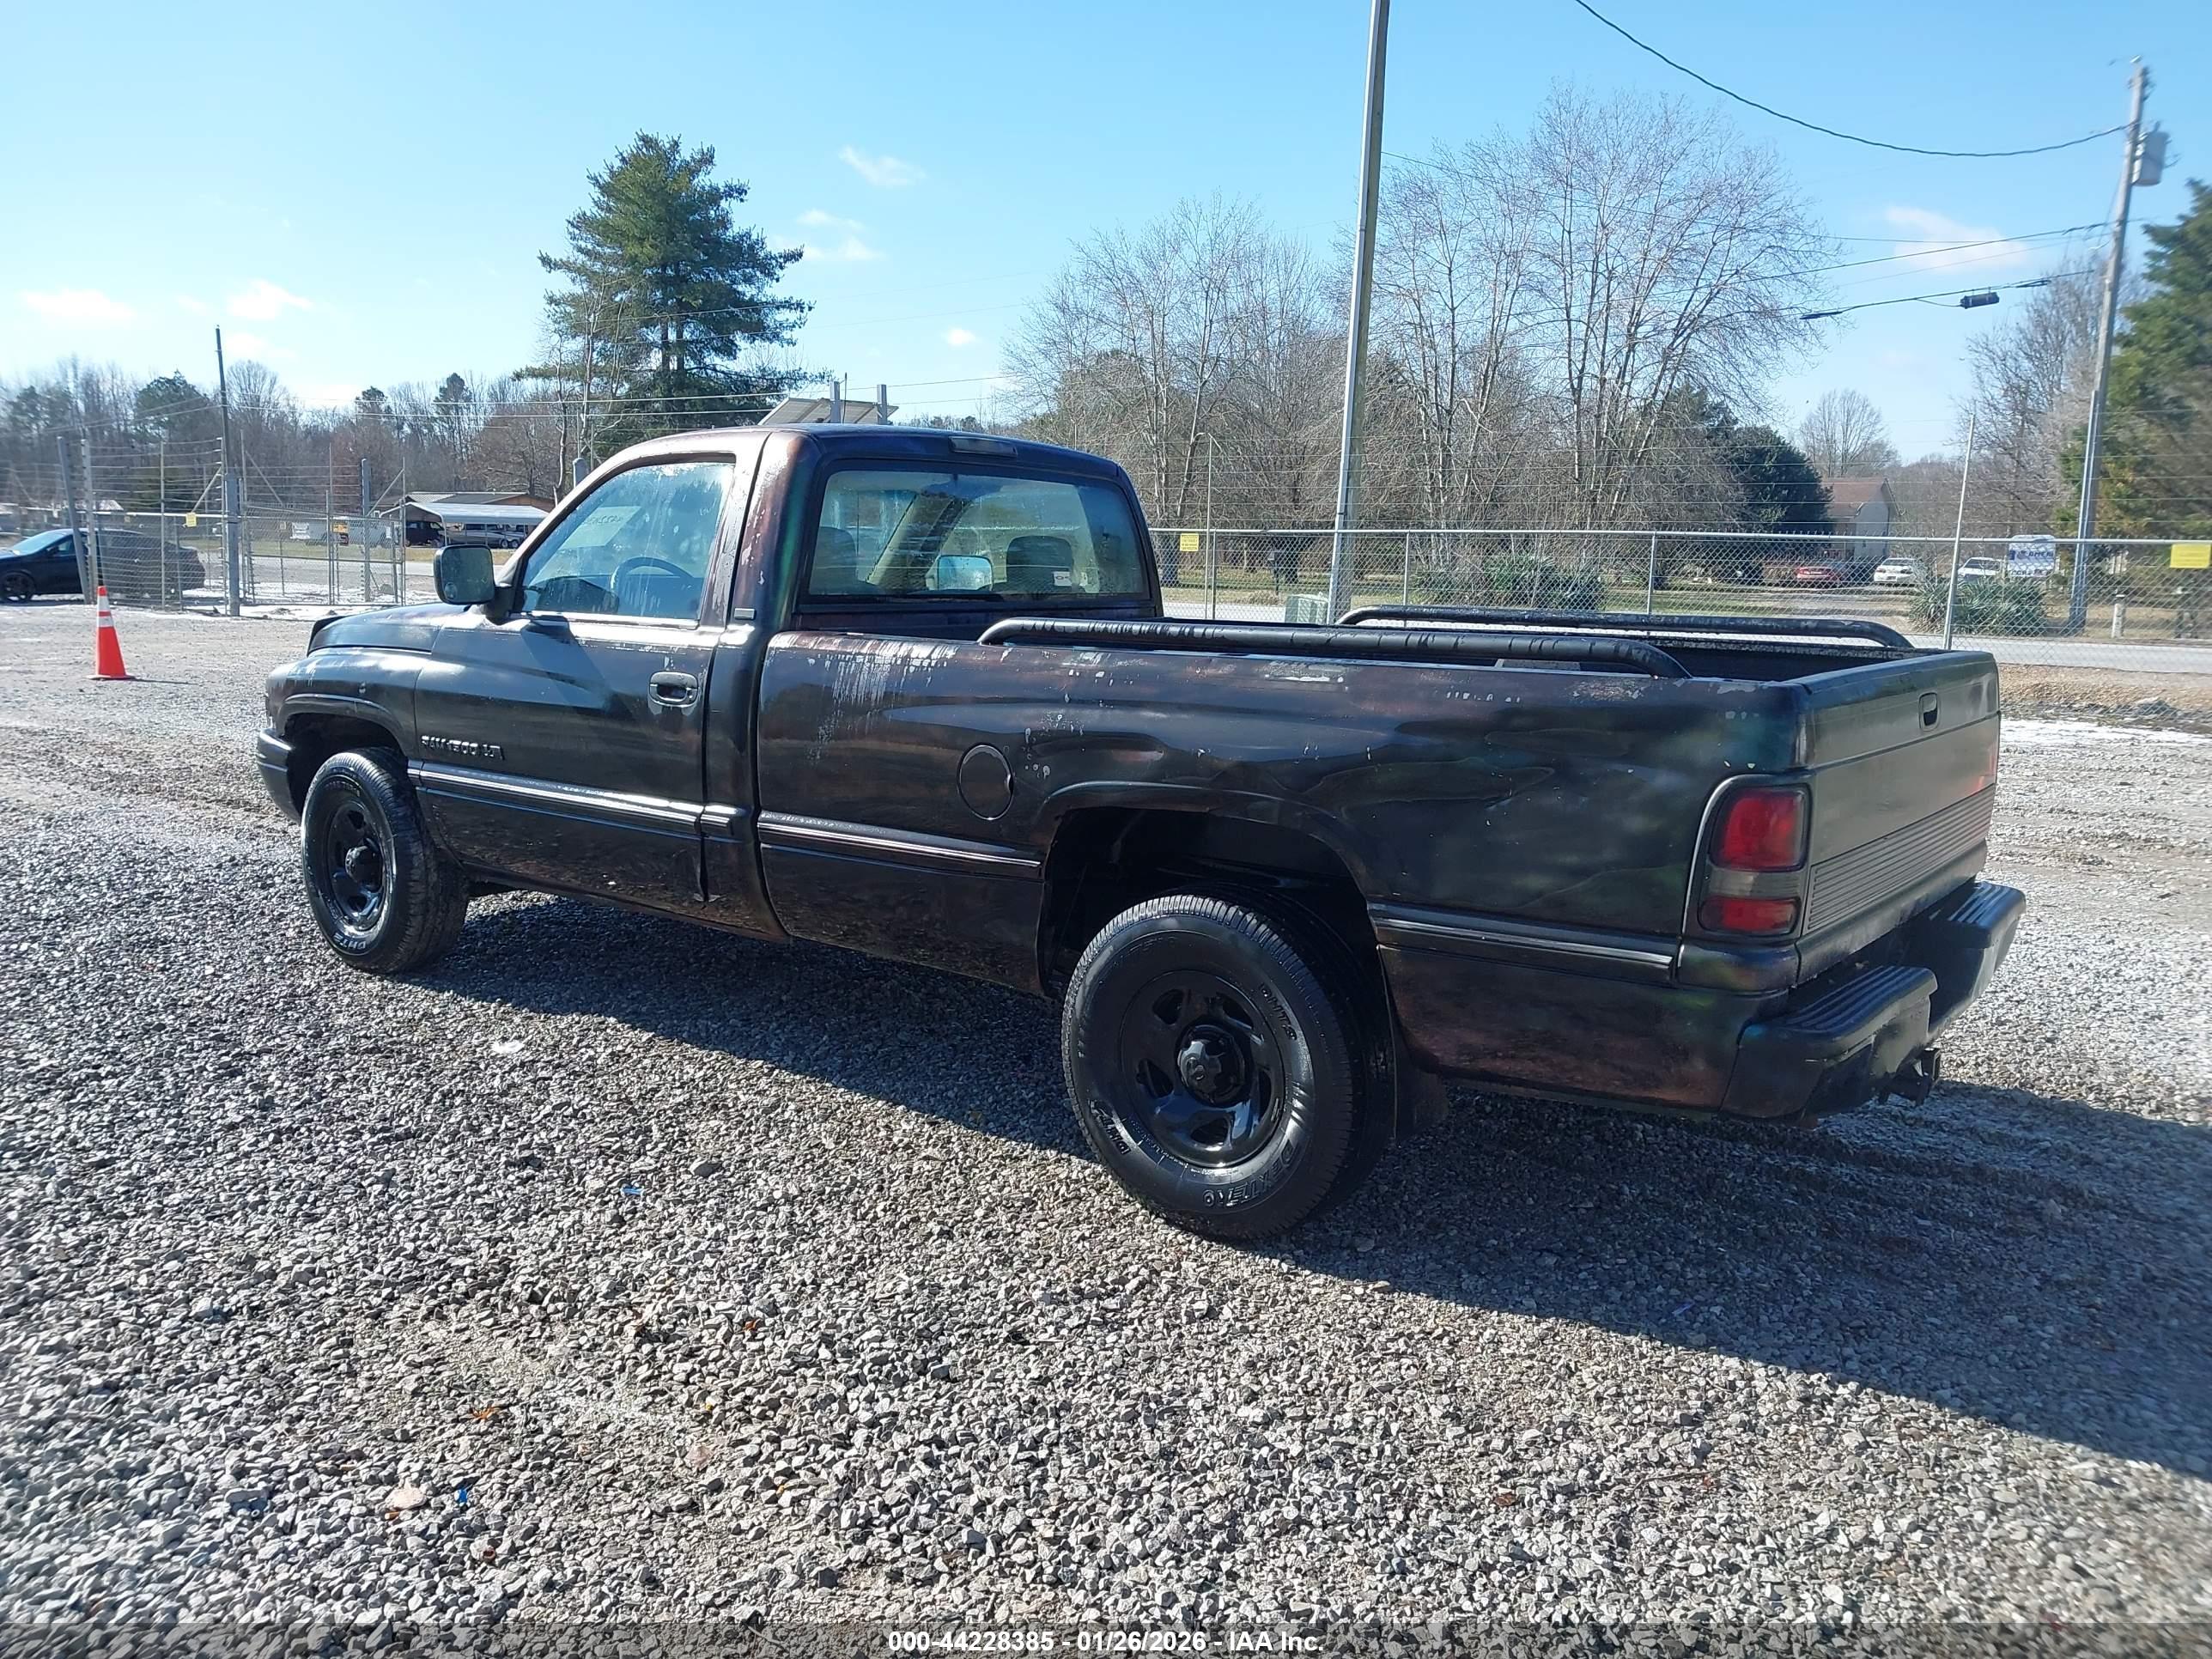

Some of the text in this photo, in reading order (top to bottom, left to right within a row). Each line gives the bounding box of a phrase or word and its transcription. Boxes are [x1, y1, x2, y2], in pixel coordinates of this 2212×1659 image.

[421, 735, 446, 750] RAM
[446, 739, 479, 756] 1500
[1201, 1139, 1299, 1208] DEXTERO
